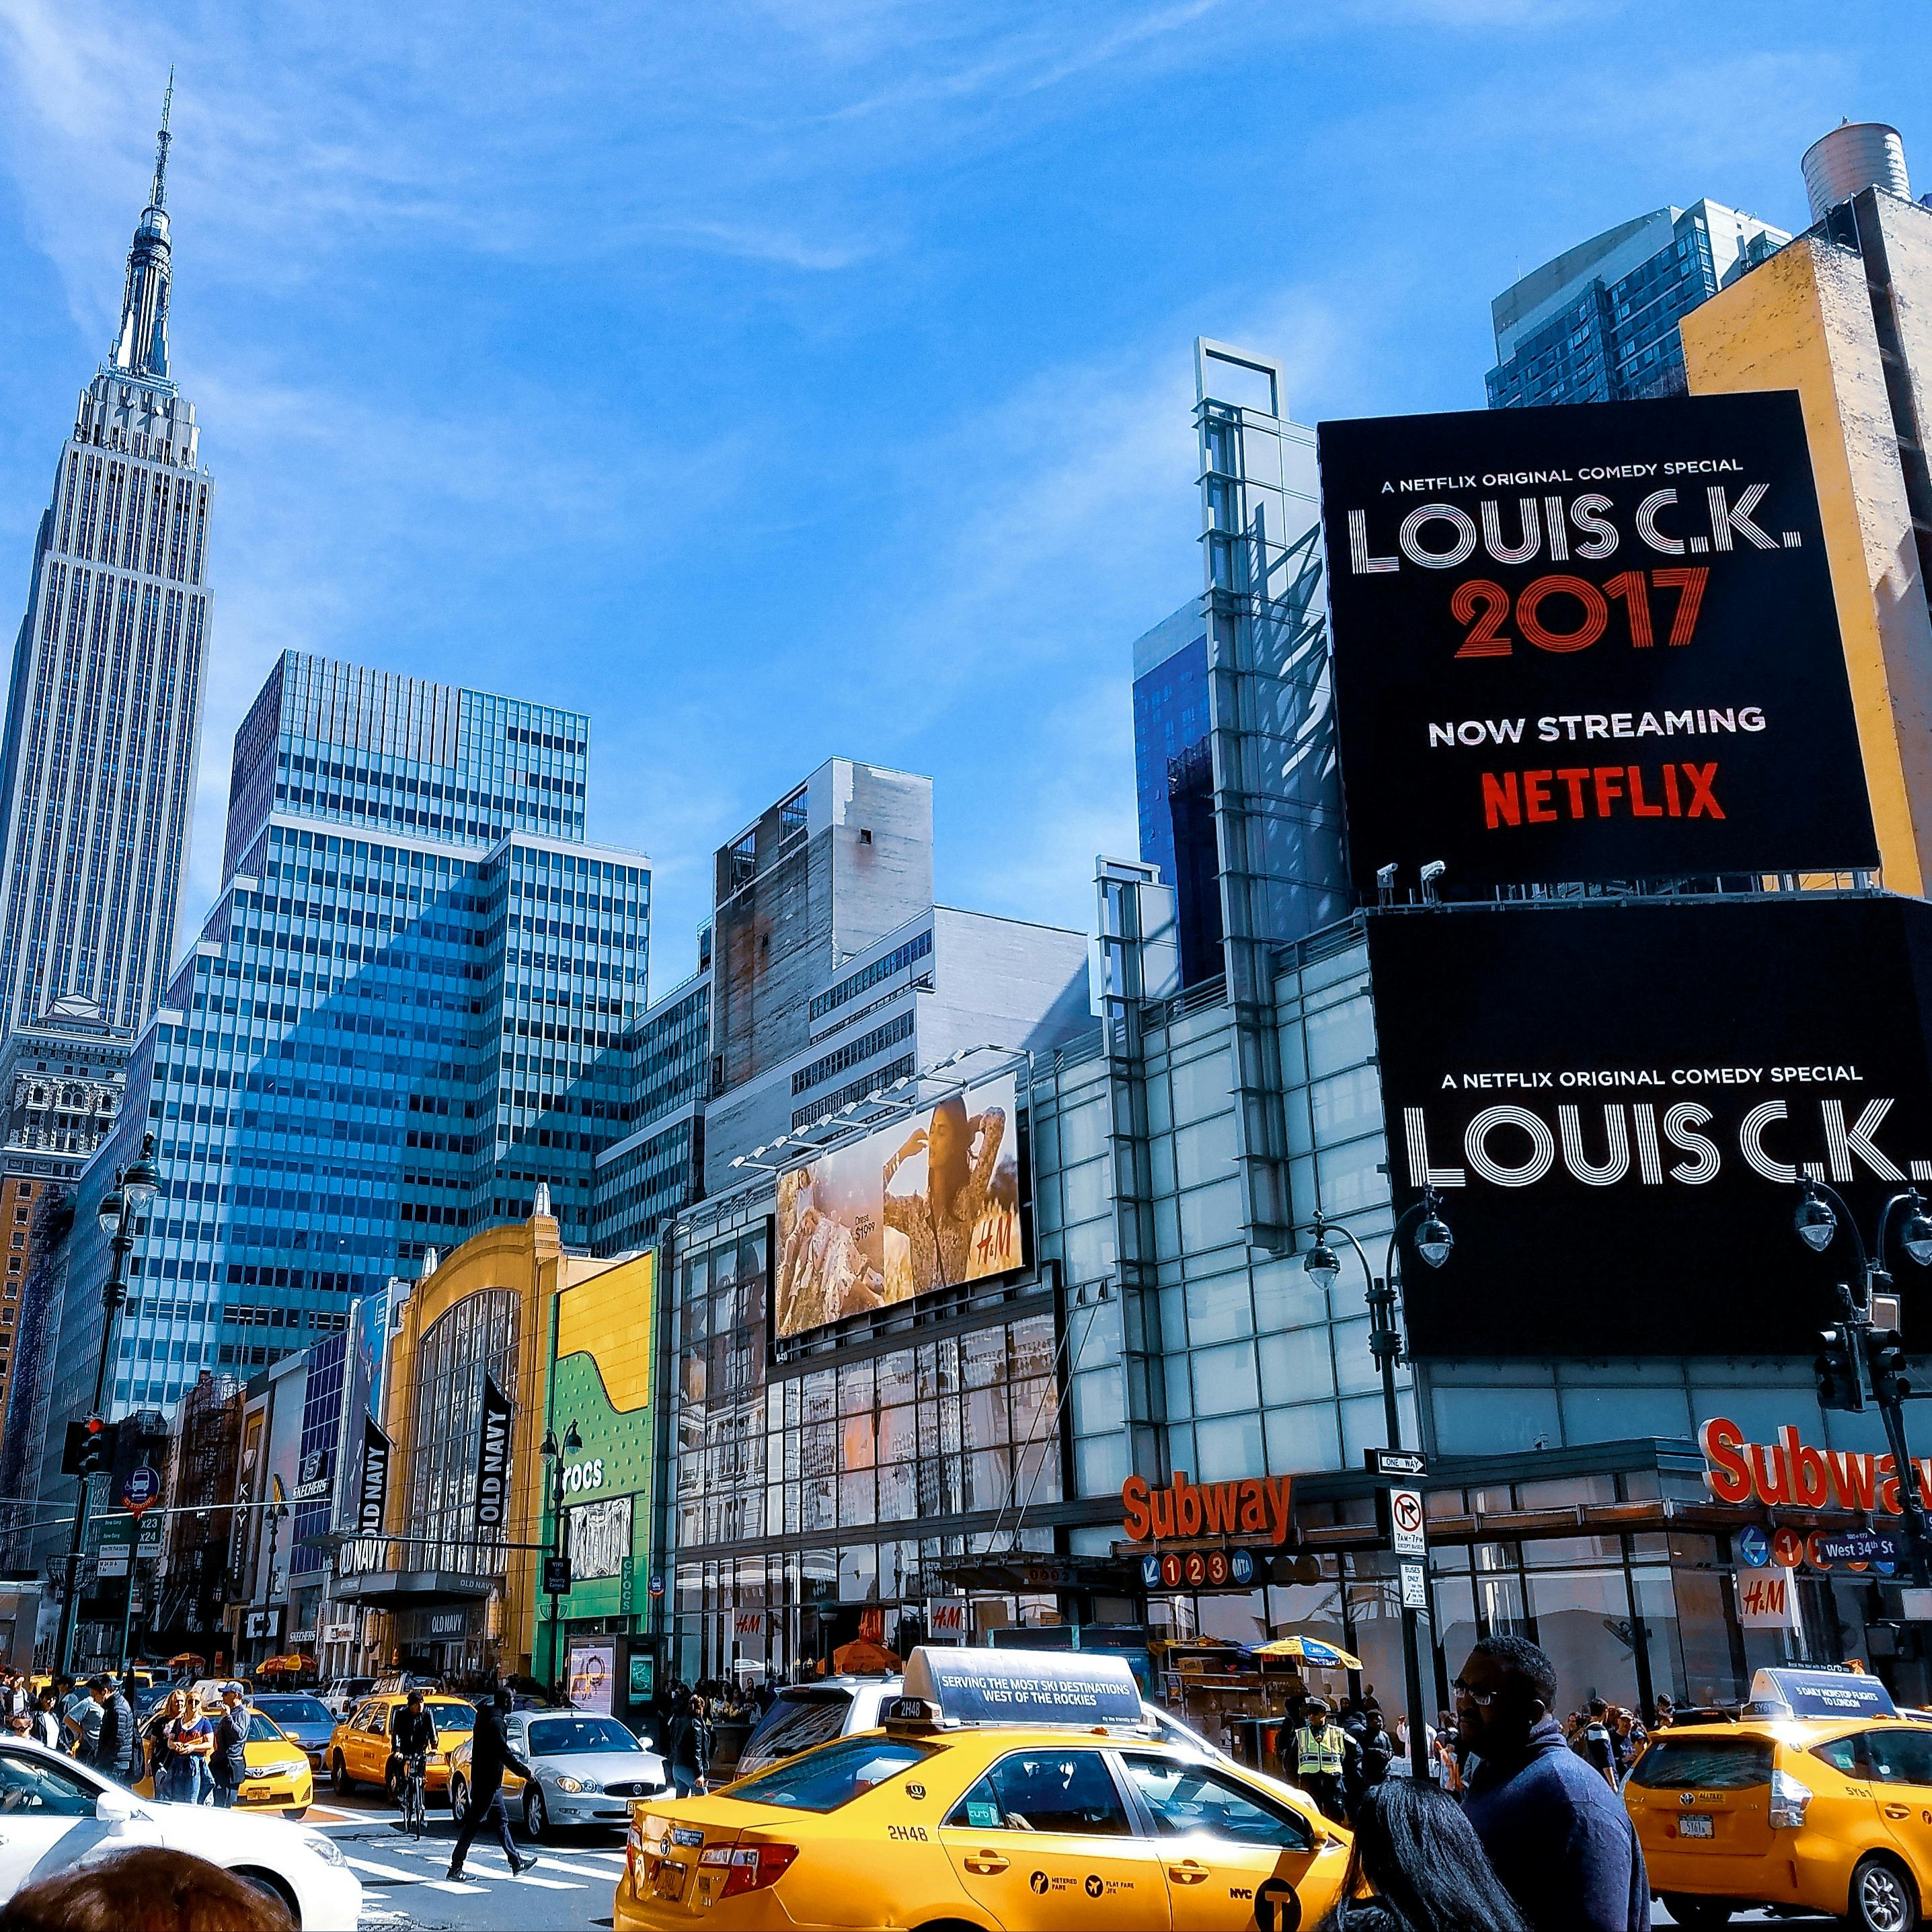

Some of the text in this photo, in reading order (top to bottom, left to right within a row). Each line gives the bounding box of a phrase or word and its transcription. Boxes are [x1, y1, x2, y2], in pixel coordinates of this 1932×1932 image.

[1382, 459, 1744, 494] A NETFLIX ORIGINAL COMEDY SPECIAL
[1348, 483, 1803, 575] LOUIS C.K.
[1451, 566, 1710, 658] 2017
[1428, 707, 1767, 748] NOW STREAMING
[1481, 763, 1727, 829] NETFLIX
[1441, 1065, 1863, 1089] A NETFLIX ORIGINAL COMEDY SPECIAL
[1403, 1098, 1932, 1187] LOUIS C.K.
[976, 1213, 1012, 1266] H&M
[480, 1409, 506, 1522] OLD NAVY
[1386, 1458, 1419, 1468] ONE WAY
[553, 1458, 603, 1495] rocs
[293, 1479, 327, 1500] SKECHERS
[362, 1446, 385, 1536] OLD NAVY
[237, 1483, 249, 1528] KAY
[1122, 1471, 1293, 1545] Subway
[1396, 1533, 1423, 1543] 7AM-7PM
[1782, 1535, 1793, 1561] 1
[1825, 1544, 1855, 1557] West
[1857, 1540, 1878, 1555] 34th
[1881, 1541, 1894, 1554] St
[339, 1539, 387, 1578] OLD NAVY
[1167, 1557, 1251, 1581] 1 2 3 MTA
[460, 1579, 495, 1590] OLD NAVY
[623, 1559, 632, 1611] crocs
[1743, 1580, 1785, 1615] H&M
[431, 1614, 462, 1633] OLD NAVY
[736, 1613, 762, 1635] H&M
[932, 1606, 963, 1630] H&M
[289, 1629, 316, 1643] SKECHERS
[941, 1675, 1130, 1695] SERVING THE MOST SKI DESTINATIONS
[1795, 1687, 1879, 1701] 5 DAILY NONSTOP FLIGHTS
[901, 1701, 921, 1717] 2H48
[982, 1689, 1097, 1706] WEST OF THE ROCKIES
[1754, 1703, 1771, 1713] 5Y61
[1822, 1696, 1861, 1708] TO LONDON
[1845, 1787, 1873, 1798] 5Y61
[969, 1810, 989, 1818] curb
[888, 1825, 929, 1842] 2H48
[1051, 1877, 1077, 1885] METERED
[1230, 1887, 1253, 1900] NYC
